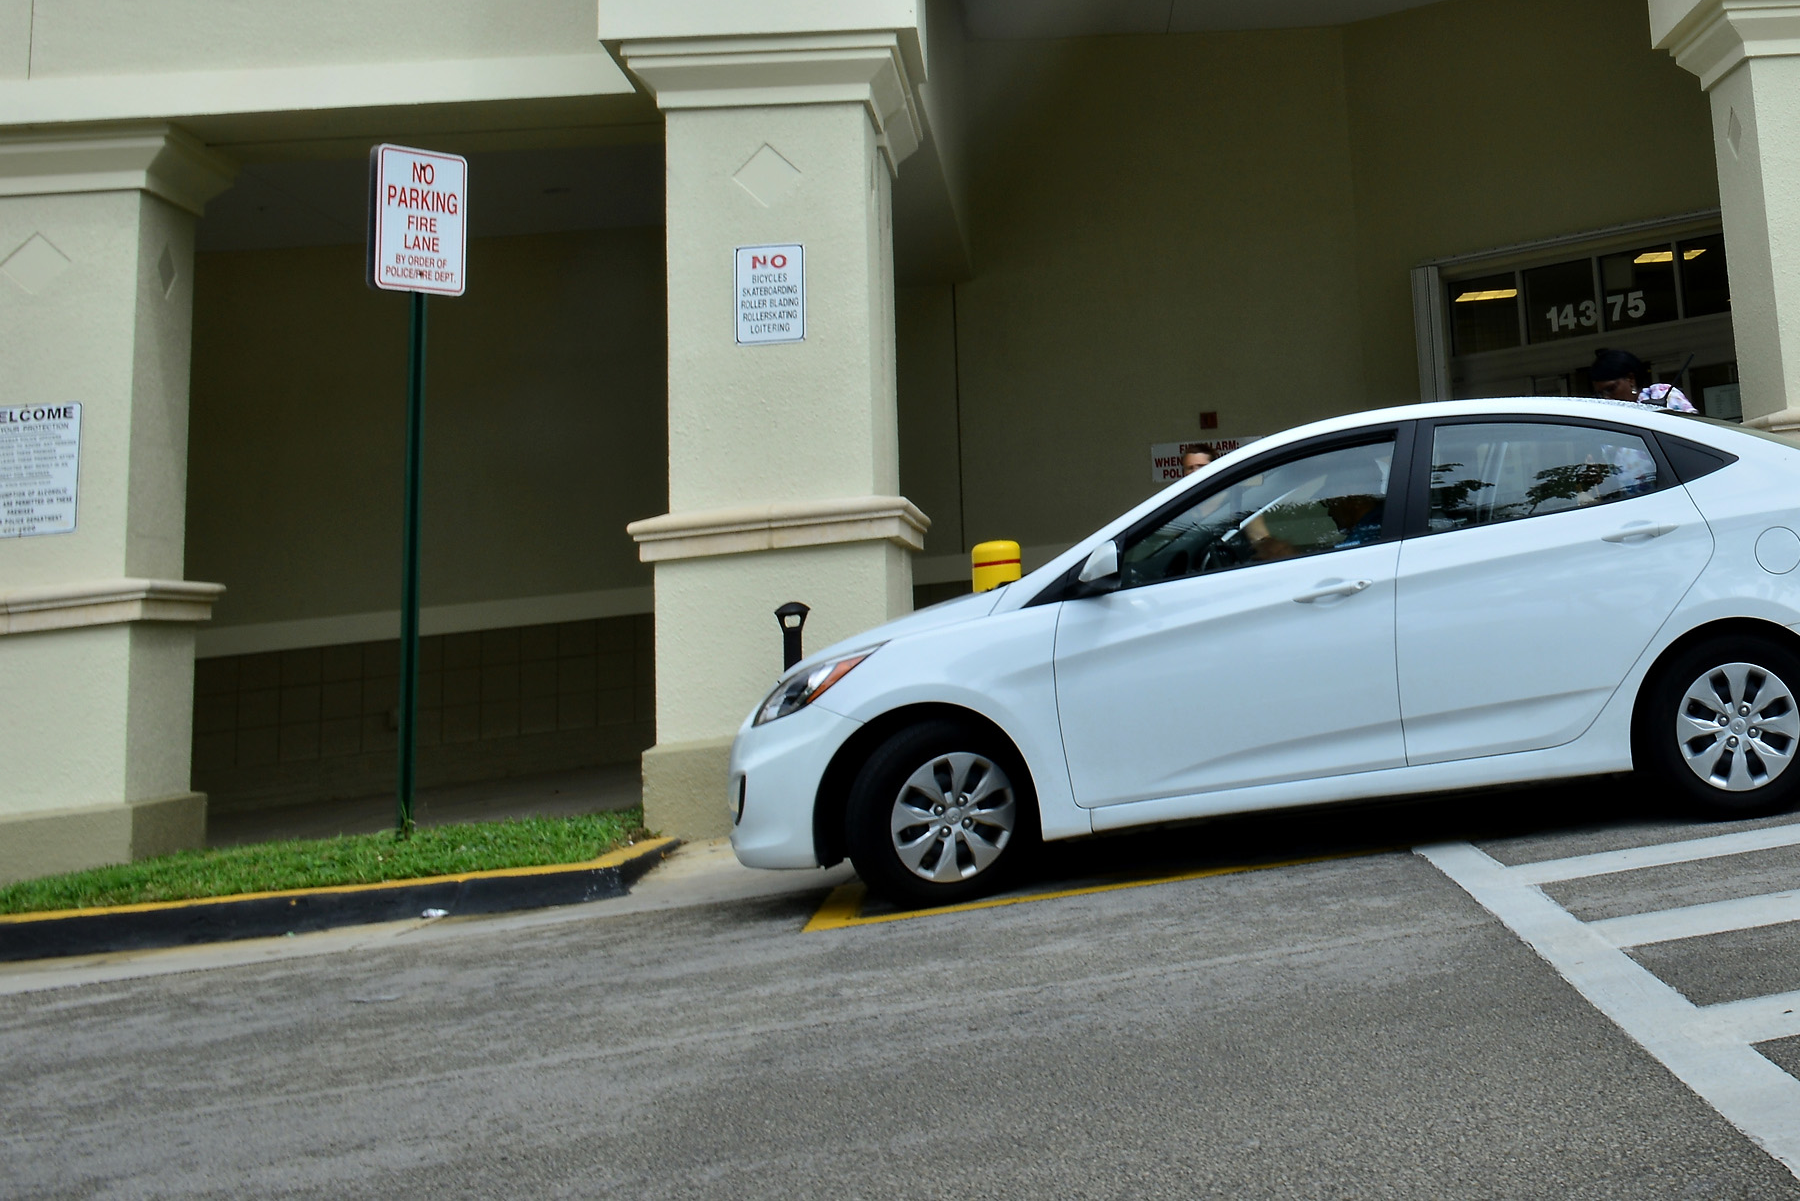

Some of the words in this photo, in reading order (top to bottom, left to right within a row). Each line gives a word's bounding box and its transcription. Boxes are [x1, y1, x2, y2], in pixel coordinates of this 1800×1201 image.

[412, 162, 435, 185] NO
[387, 185, 458, 215] PARKING
[407, 215, 437, 234] FIRE
[404, 234, 440, 253] LANE
[395, 253, 406, 265] BY
[408, 256, 435, 268] ORDER
[437, 259, 447, 269] OF
[752, 255, 787, 269] NO
[435, 271, 456, 283] DEPT.
[752, 273, 787, 284] BICYCLES
[742, 285, 797, 297] SKATEBOARDING
[741, 299, 767, 310] ROLLER
[769, 297, 799, 308] BLADING
[743, 310, 797, 322] ROLLERSKATING
[750, 323, 790, 334] LOITERING
[1163, 468, 1184, 478] POLI
